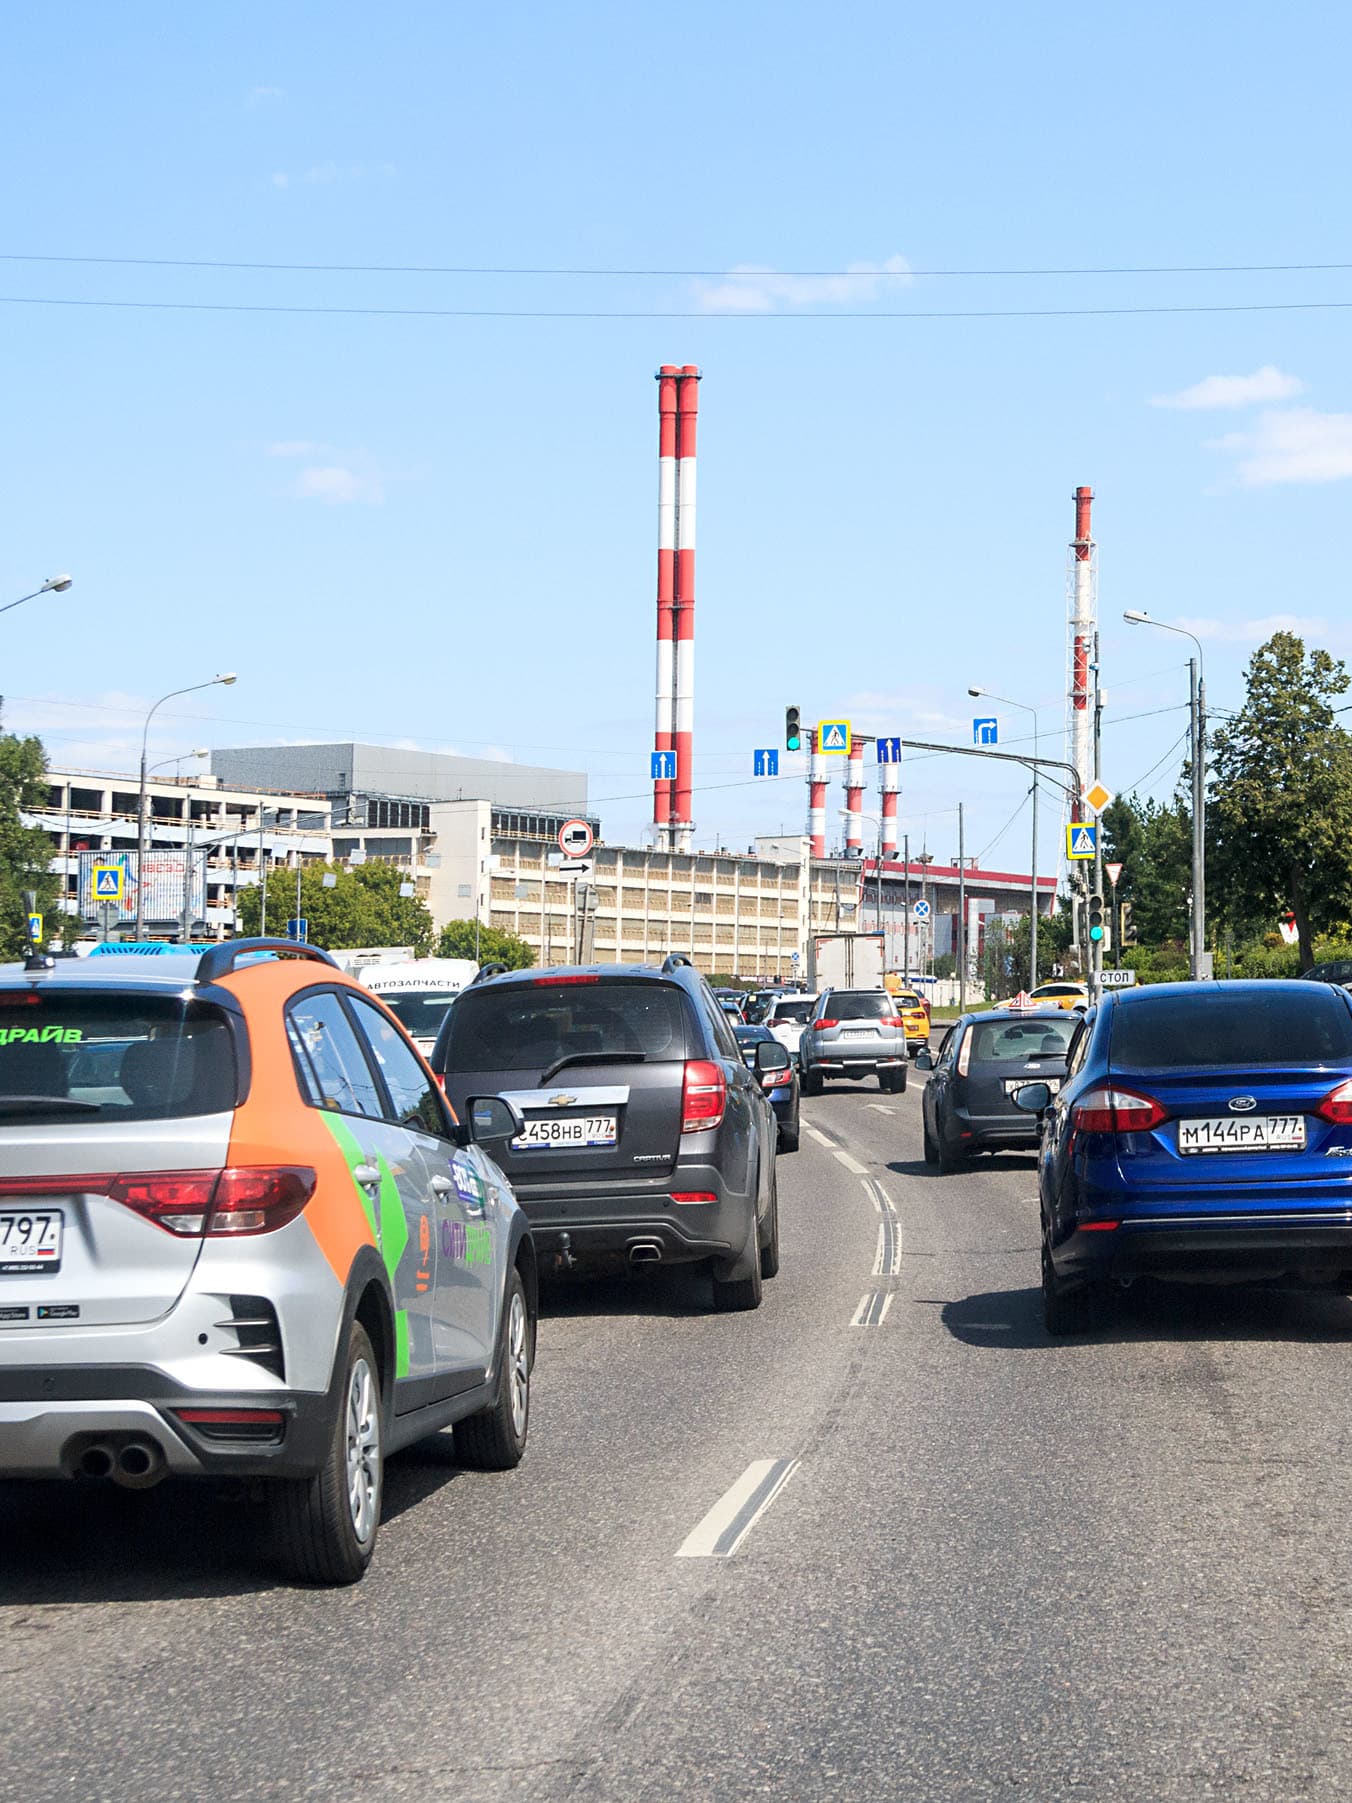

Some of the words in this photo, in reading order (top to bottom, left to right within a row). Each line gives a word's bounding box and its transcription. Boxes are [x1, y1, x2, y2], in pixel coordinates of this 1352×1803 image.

[1100, 973, 1128, 982] СТОП
[368, 980, 460, 990] АВТОЗАПЧАСТИ
[587, 1120, 610, 1133] 777
[1186, 1121, 1264, 1144] М144РА
[1269, 1118, 1298, 1134] 777
[0, 1216, 51, 1245] 797
[10, 1246, 36, 1256] RUS
